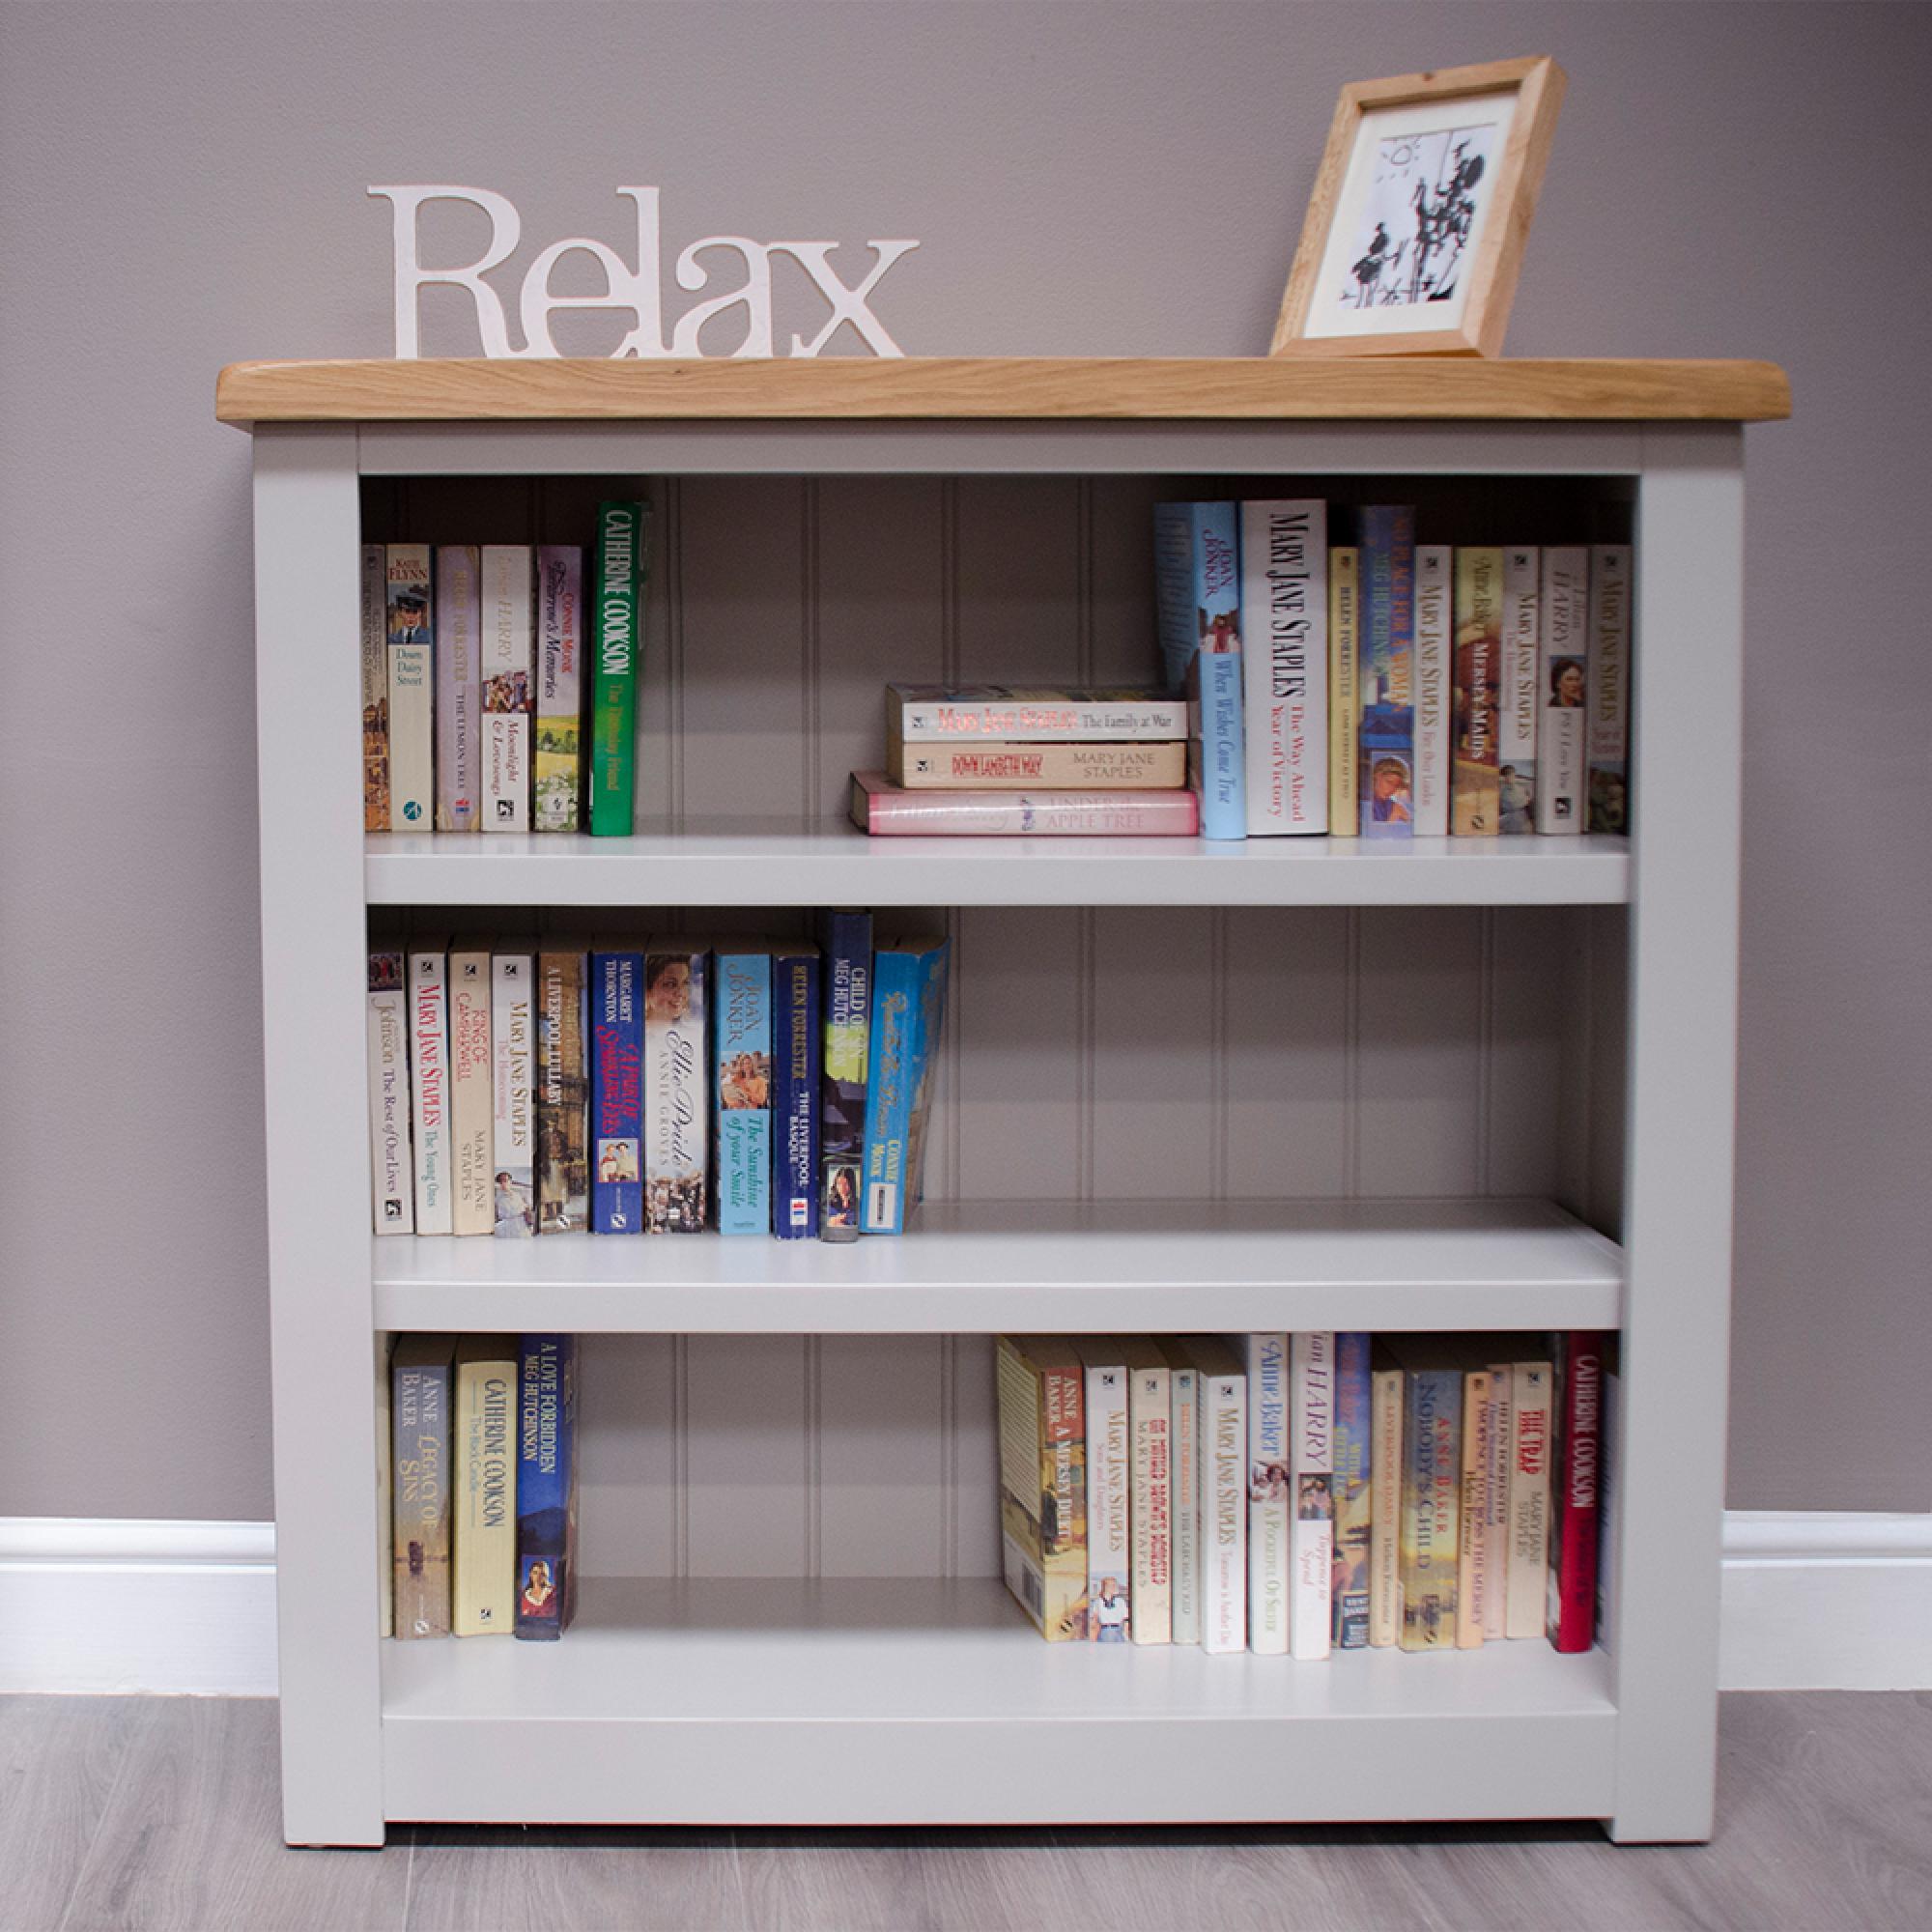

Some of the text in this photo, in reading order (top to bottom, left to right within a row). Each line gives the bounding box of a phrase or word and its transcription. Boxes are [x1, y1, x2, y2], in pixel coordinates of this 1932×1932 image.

[366, 185, 921, 359] Relax
[388, 567, 428, 581] FLYNN
[601, 509, 633, 676] CATHERINE COOKSON
[1203, 528, 1220, 599] JONKER
[1219, 541, 1236, 587] JOAN
[561, 593, 575, 673] CONNIE MONK
[1266, 513, 1312, 698] MARY JANE STAPLES
[1339, 586, 1351, 625] HELEN
[1550, 572, 1572, 645] HARRY
[1600, 581, 1625, 622] MARY
[545, 634, 561, 698] Memories
[1339, 629, 1351, 697] FORRESTER
[1420, 585, 1443, 727] MARY JANE STAPLES
[1517, 593, 1538, 741] MARY JANE STAPLES
[1599, 625, 1624, 658] JANE
[1470, 642, 1489, 759] MERSEY MAIDS
[1599, 663, 1623, 723] STAPLES
[490, 736, 503, 796] Lovesongs
[505, 720, 520, 782] Moonlight
[1073, 753, 1156, 767] MARY JANE
[1214, 661, 1236, 805] When Wishes Come True
[1267, 705, 1285, 817] Year of Victory
[1287, 705, 1305, 822] The Way Ahead
[1084, 766, 1145, 780] STAPLES
[1101, 814, 1145, 829] TREE
[605, 958, 618, 1023] THORNTON
[619, 959, 633, 1023] MARGARET
[744, 976, 764, 1033] JOAN
[833, 957, 850, 984] MEG
[849, 967, 867, 1010] CHILD
[371, 996, 399, 1065] Johnson
[456, 992, 473, 1082] CAMBERWELL
[471, 1009, 488, 1065] KING OF
[547, 978, 563, 1048] LIVERPOOL
[725, 963, 747, 1047] JONKER
[791, 965, 809, 1079] HELEN FORRESTER
[849, 1014, 867, 1031] OF
[383, 1069, 396, 1093] The
[416, 984, 443, 1126] MARY JANE STAPLES
[497, 1039, 509, 1058] The
[509, 1002, 529, 1148] MARY JANE STAPLES
[547, 1050, 563, 1106] LULLABY
[383, 1096, 397, 1122] Rest
[659, 1050, 669, 1167] ANNIE GROVES
[666, 1030, 695, 1167] Ellie Pride
[727, 1117, 746, 1133] of
[384, 1137, 398, 1162] Our
[422, 1130, 440, 1207] The Young Ones
[461, 1143, 474, 1201] STAPLES
[473, 1130, 487, 1212] MARY JANE
[725, 1134, 743, 1164] your
[748, 1117, 764, 1208] The Sunshine
[798, 1091, 810, 1187] THE LIVERPOOL
[869, 1143, 884, 1178] MONK
[385, 1162, 400, 1193] Lives
[729, 1166, 746, 1208] Smile
[401, 1373, 421, 1428] BAKER
[422, 1376, 441, 1423] ANNE
[469, 1415, 482, 1435] The
[524, 1354, 539, 1462] MEG HUTCHINSON
[540, 1343, 557, 1474] A LOVE FORBIDDEN
[1048, 1376, 1063, 1425] BAKER
[1063, 1378, 1077, 1421] ANNE
[1260, 1340, 1284, 1458] Anne Baker
[1305, 1366, 1329, 1467] HARRY
[1575, 1354, 1599, 1433] CATHERINE
[469, 1436, 482, 1460] Black
[482, 1378, 507, 1527] CATHERINE COOKSON
[1436, 1417, 1455, 1534] ANNE BAKER
[1517, 1409, 1546, 1475] THE TRAP
[1570, 1437, 1597, 1508] COOKSON
[399, 1459, 420, 1503] SINS
[417, 1435, 442, 1529] LEGACY OF
[1055, 1426, 1072, 1539] A MERSEY DUET
[1106, 1411, 1126, 1552] MARY JANE STAPLES
[1135, 1420, 1149, 1588] MARY JANE STAPLES
[1214, 1407, 1239, 1546] MARY JANE STAPLES
[1416, 1383, 1437, 1571] NOBODY'S CHILD
[1516, 1501, 1530, 1557] STAPLES
[1528, 1492, 1543, 1566] MARY JANE
[1299, 1549, 1315, 1586] Spend
